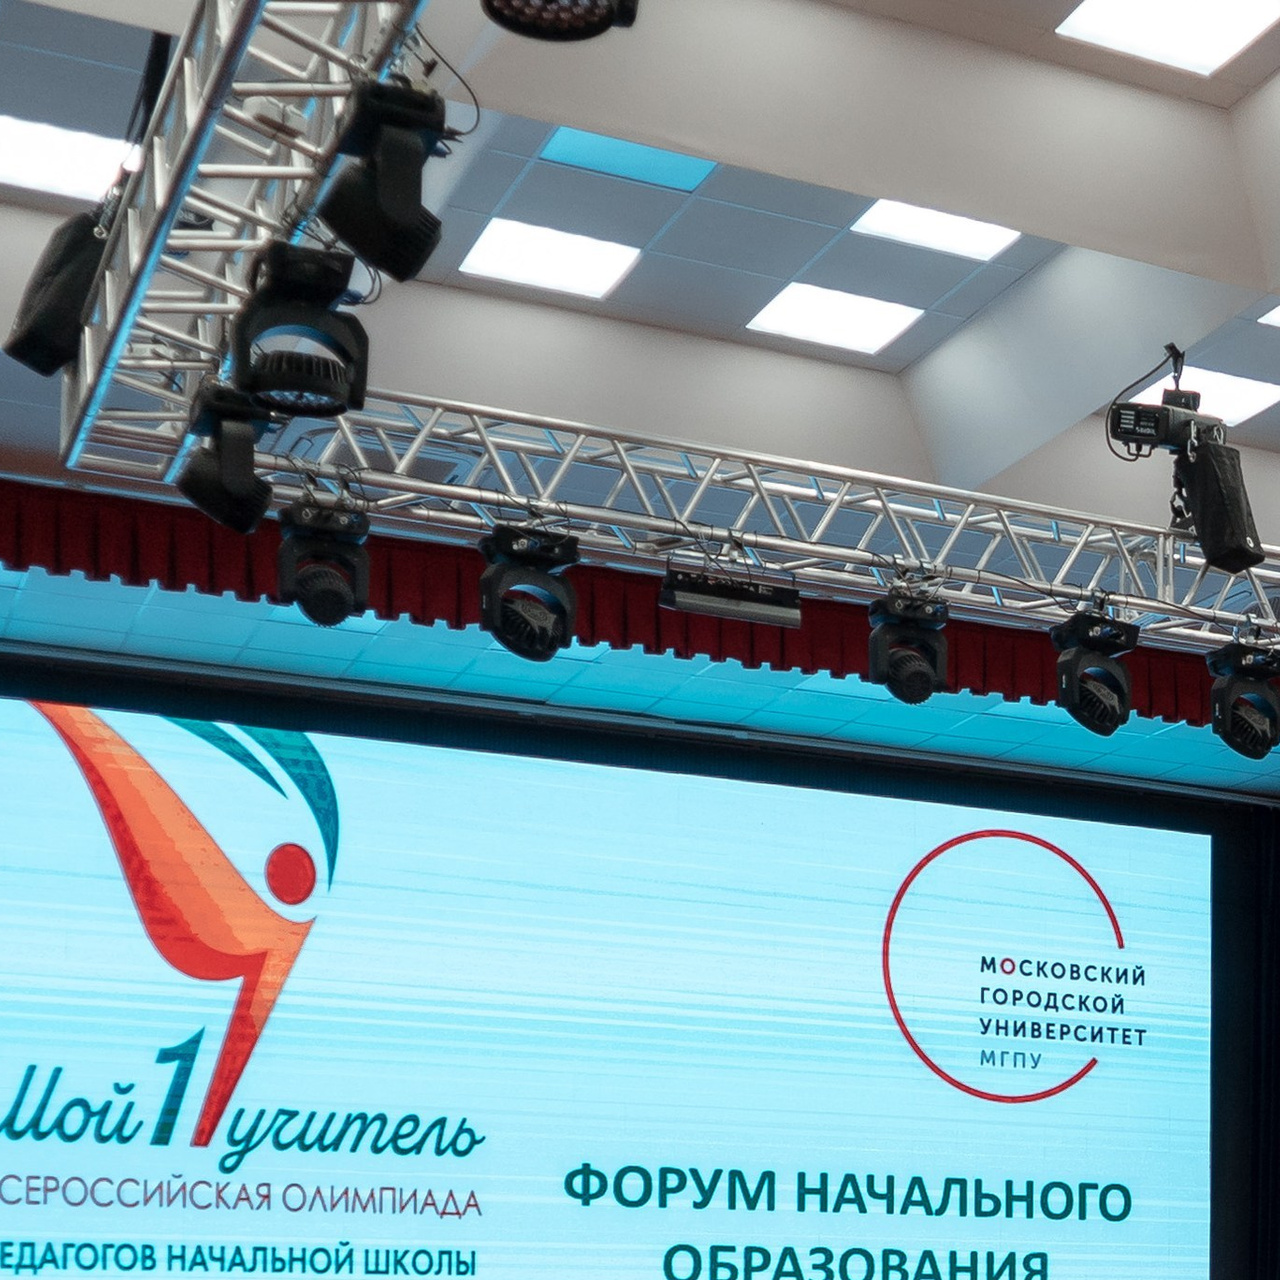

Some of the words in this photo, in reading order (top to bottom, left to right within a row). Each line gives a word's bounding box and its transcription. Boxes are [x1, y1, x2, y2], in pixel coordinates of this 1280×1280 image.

[980, 956, 1145, 986] МОСКОВСКИЙ
[980, 987, 1124, 1015] ГОРОДСКОЙ
[979, 1017, 1147, 1046] УНИВЕРСИТЕТ
[980, 1049, 1042, 1069] МГПУ
[218, 1107, 486, 1175] учитель
[0, 1173, 272, 1211] СЕРОССИЙСКАЯ
[282, 1183, 482, 1220] ОЛИМПИАДА
[563, 1162, 776, 1211] ФОРУМ
[796, 1170, 1132, 1222] НАЧАЛЬНОГО
[0, 1241, 157, 1276] ЕДАГОГОВ
[167, 1240, 354, 1276] НАЧАЛЬНОЙ
[364, 1248, 476, 1277] ШКОЛЫ
